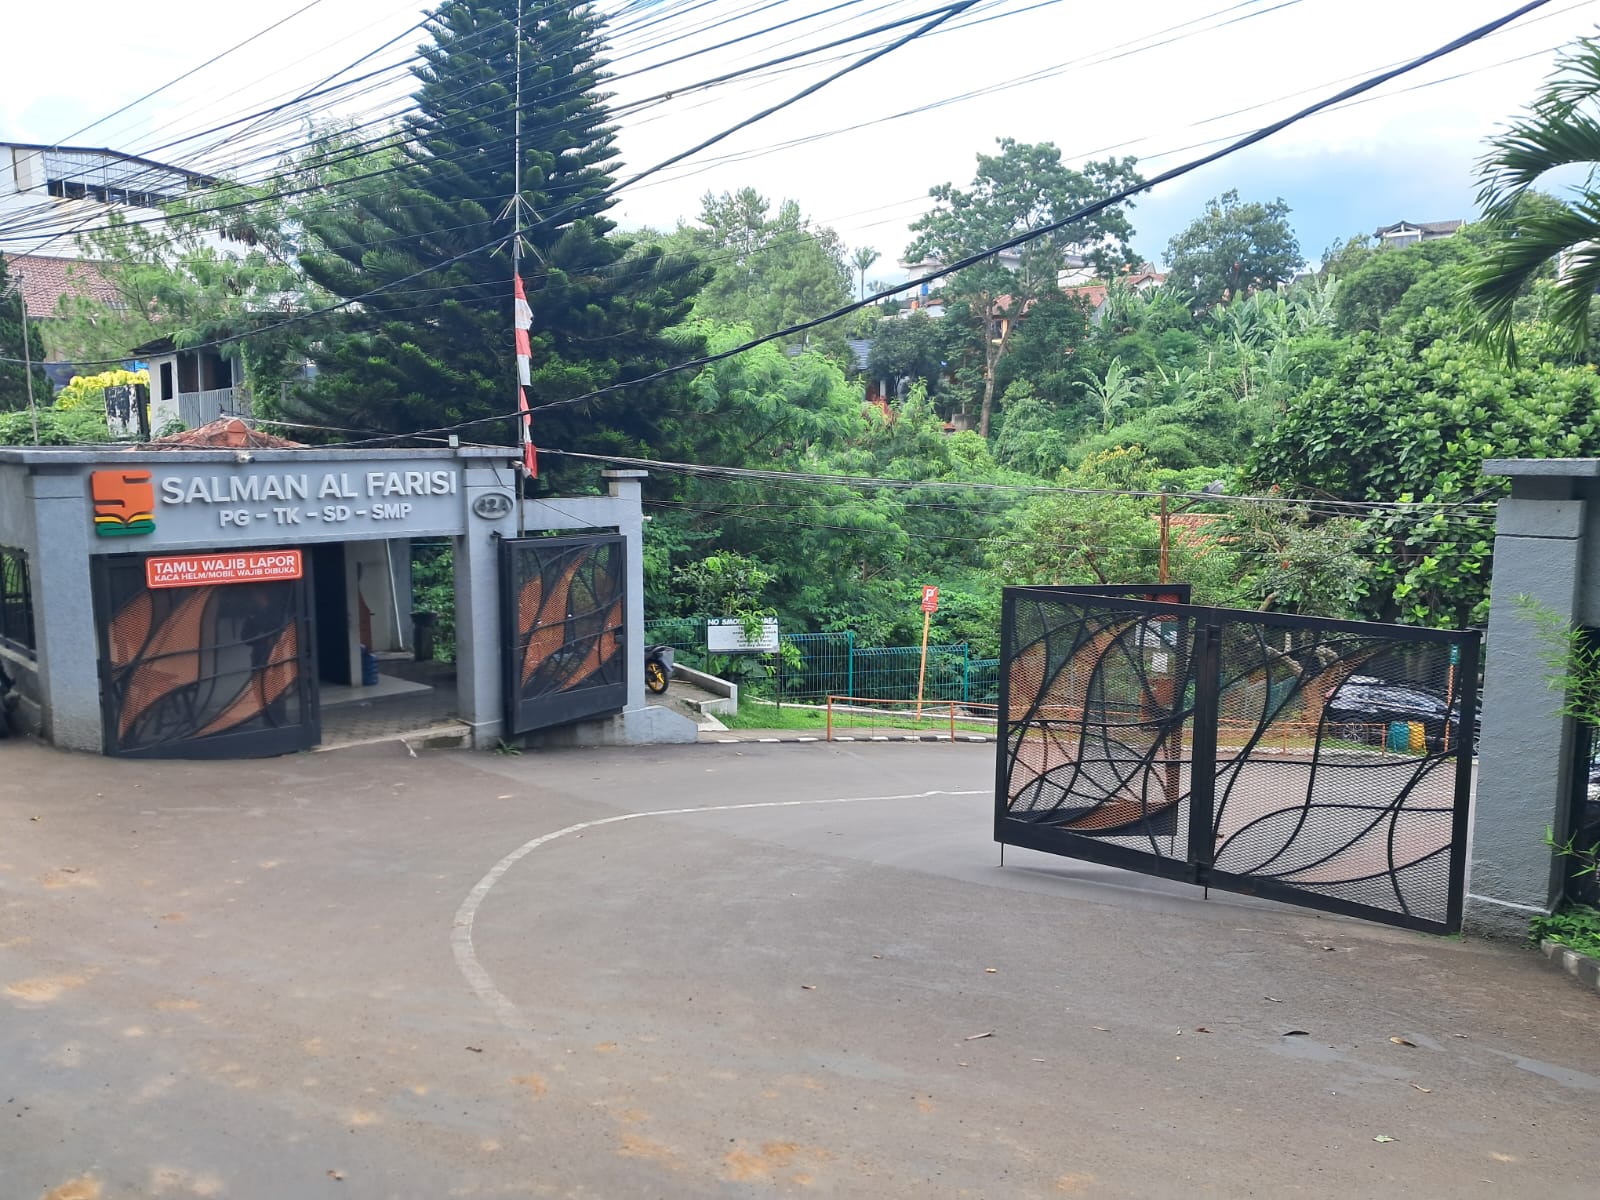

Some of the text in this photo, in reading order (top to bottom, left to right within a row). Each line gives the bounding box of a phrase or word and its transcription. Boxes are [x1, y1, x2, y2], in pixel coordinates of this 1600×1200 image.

[161, 471, 456, 504] SALMAN AL FARISI
[219, 509, 250, 527] PG
[273, 507, 301, 524] TK
[322, 505, 350, 522] SD
[372, 503, 412, 520] SMP
[154, 555, 295, 574] TAMU WAJIB LAPOR
[154, 566, 295, 582] KACA HELM/MOBIL WAJIB DIBUKA
[708, 618, 720, 626] NO
